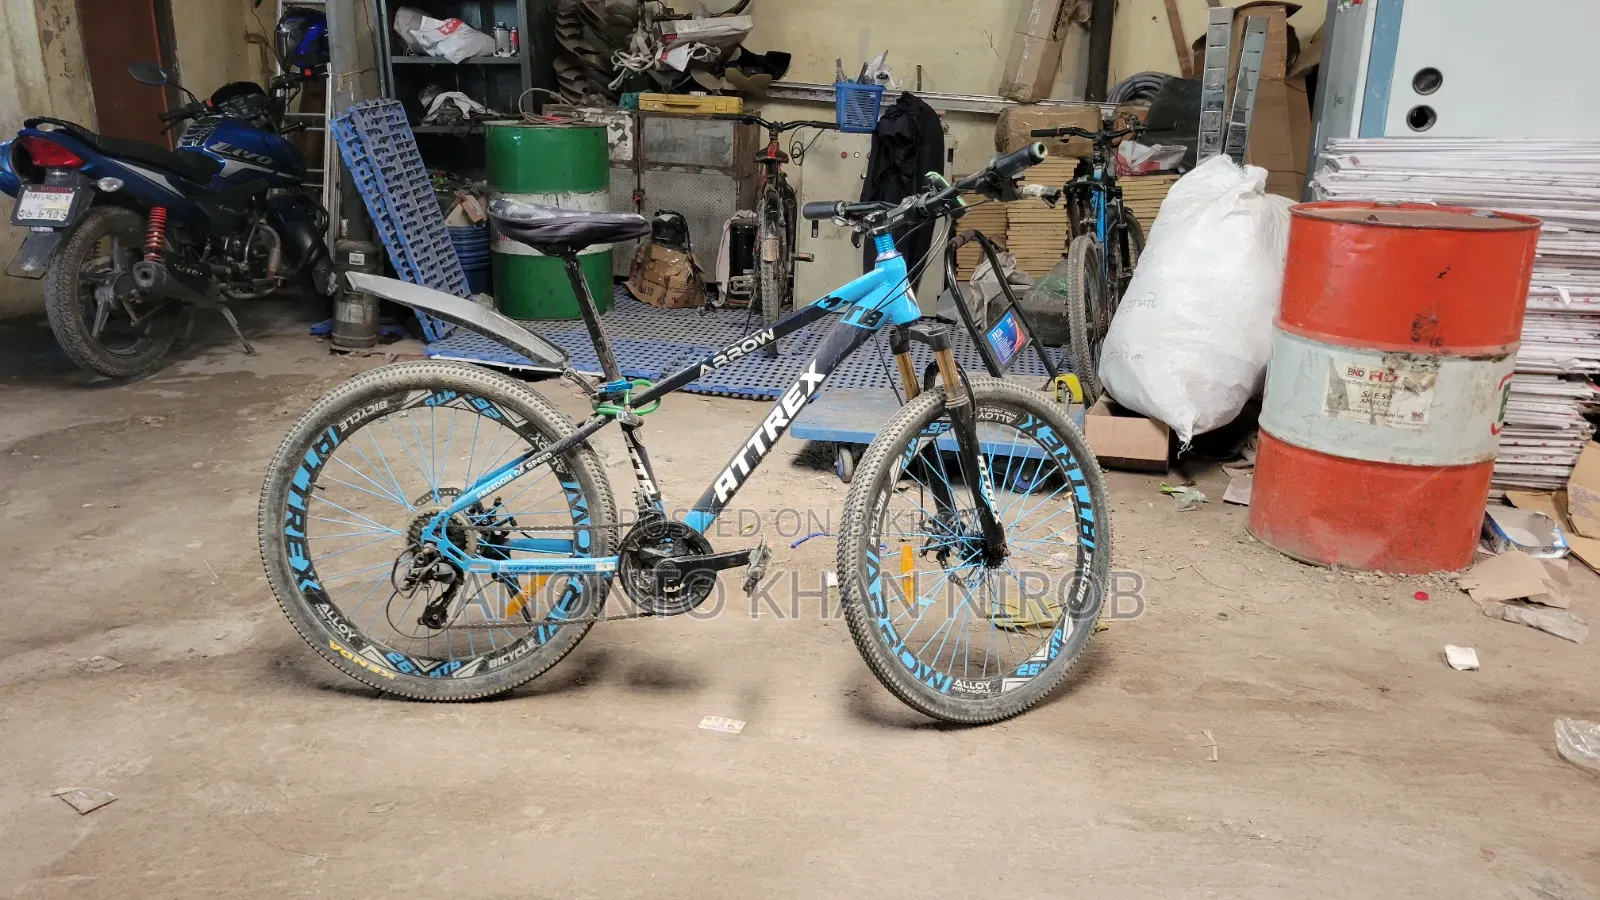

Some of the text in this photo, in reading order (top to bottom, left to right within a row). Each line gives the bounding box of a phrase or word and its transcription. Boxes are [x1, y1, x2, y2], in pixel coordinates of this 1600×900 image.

[700, 327, 774, 377] ARROW
[339, 400, 389, 433] BICYCLE
[713, 359, 825, 504] ATTREX
[977, 411, 1014, 424] ALLOY
[477, 450, 554, 500] FREEDOM OF SPEED
[1076, 552, 1092, 603] BICYCLE
[320, 602, 357, 641] ALLOY
[329, 639, 397, 681] KENDA
[489, 639, 537, 669] BICYCLE
[1050, 628, 1062, 660] MTB
[952, 679, 991, 690] ALLOY
